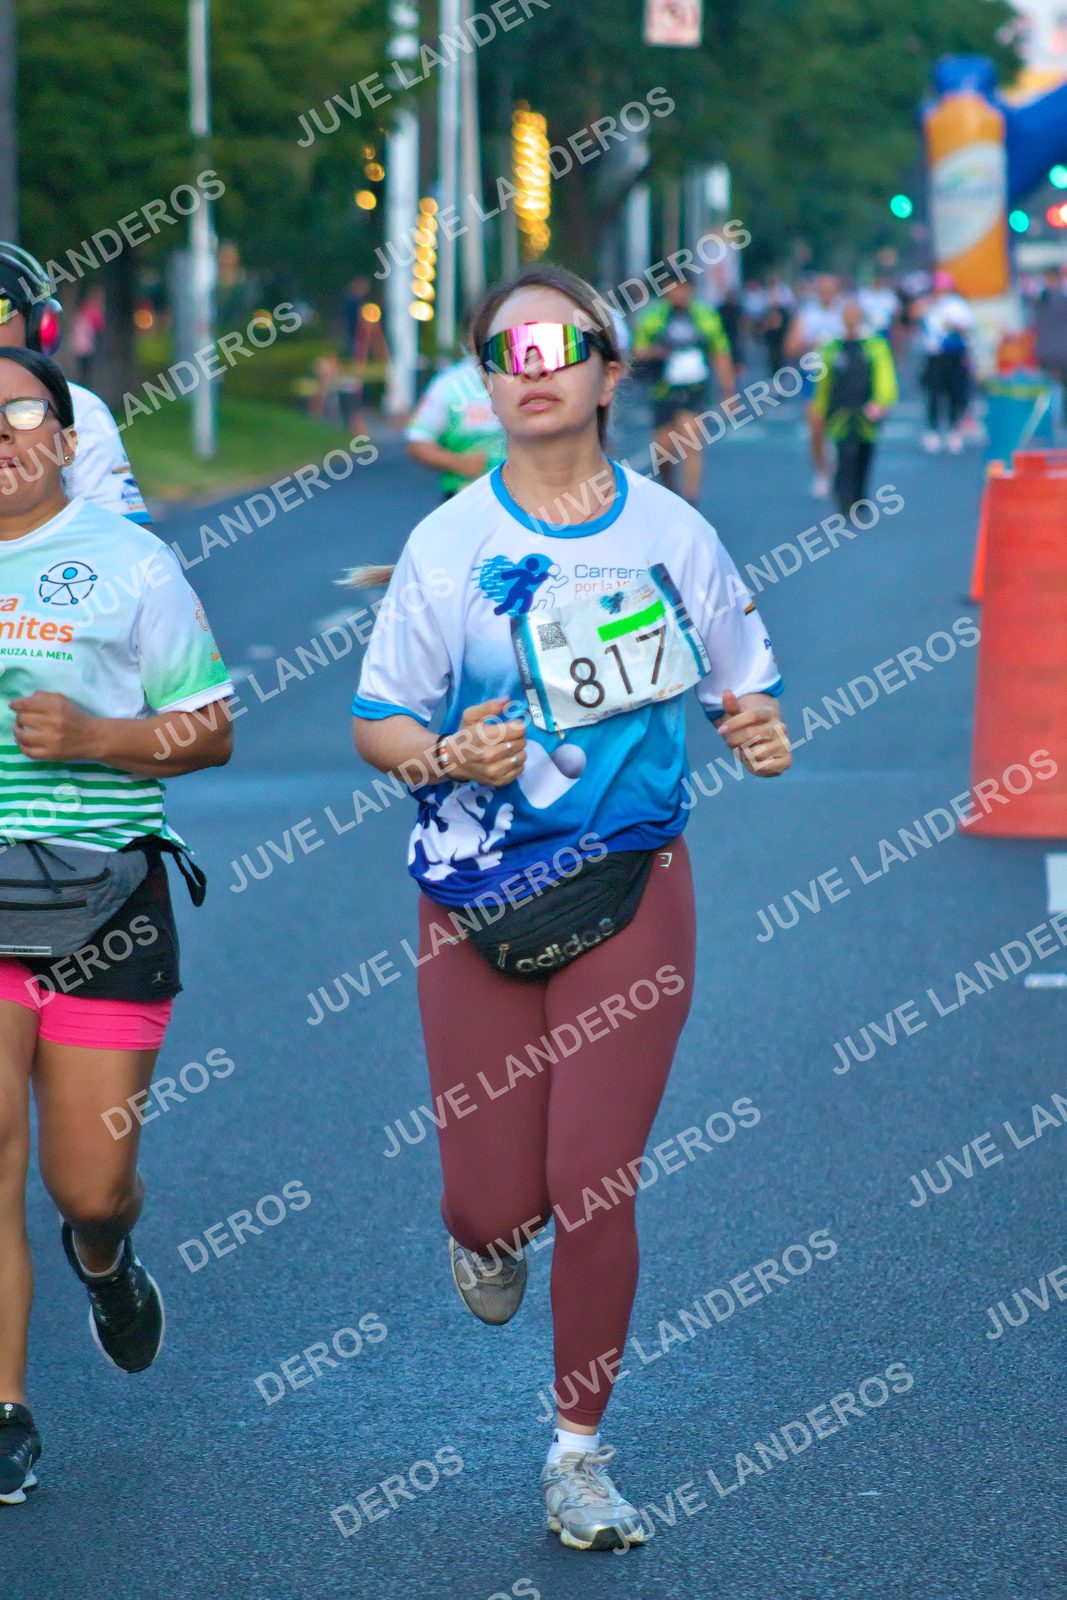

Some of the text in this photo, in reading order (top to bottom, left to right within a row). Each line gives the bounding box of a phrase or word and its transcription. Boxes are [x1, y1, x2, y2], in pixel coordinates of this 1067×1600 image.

[575, 583, 598, 594] por
[0, 597, 19, 612] a
[30, 648, 44, 658] LA
[46, 650, 74, 661] META
[569, 624, 666, 709] 817
[529, 700, 543, 720] 817
[515, 917, 616, 973] adidas
